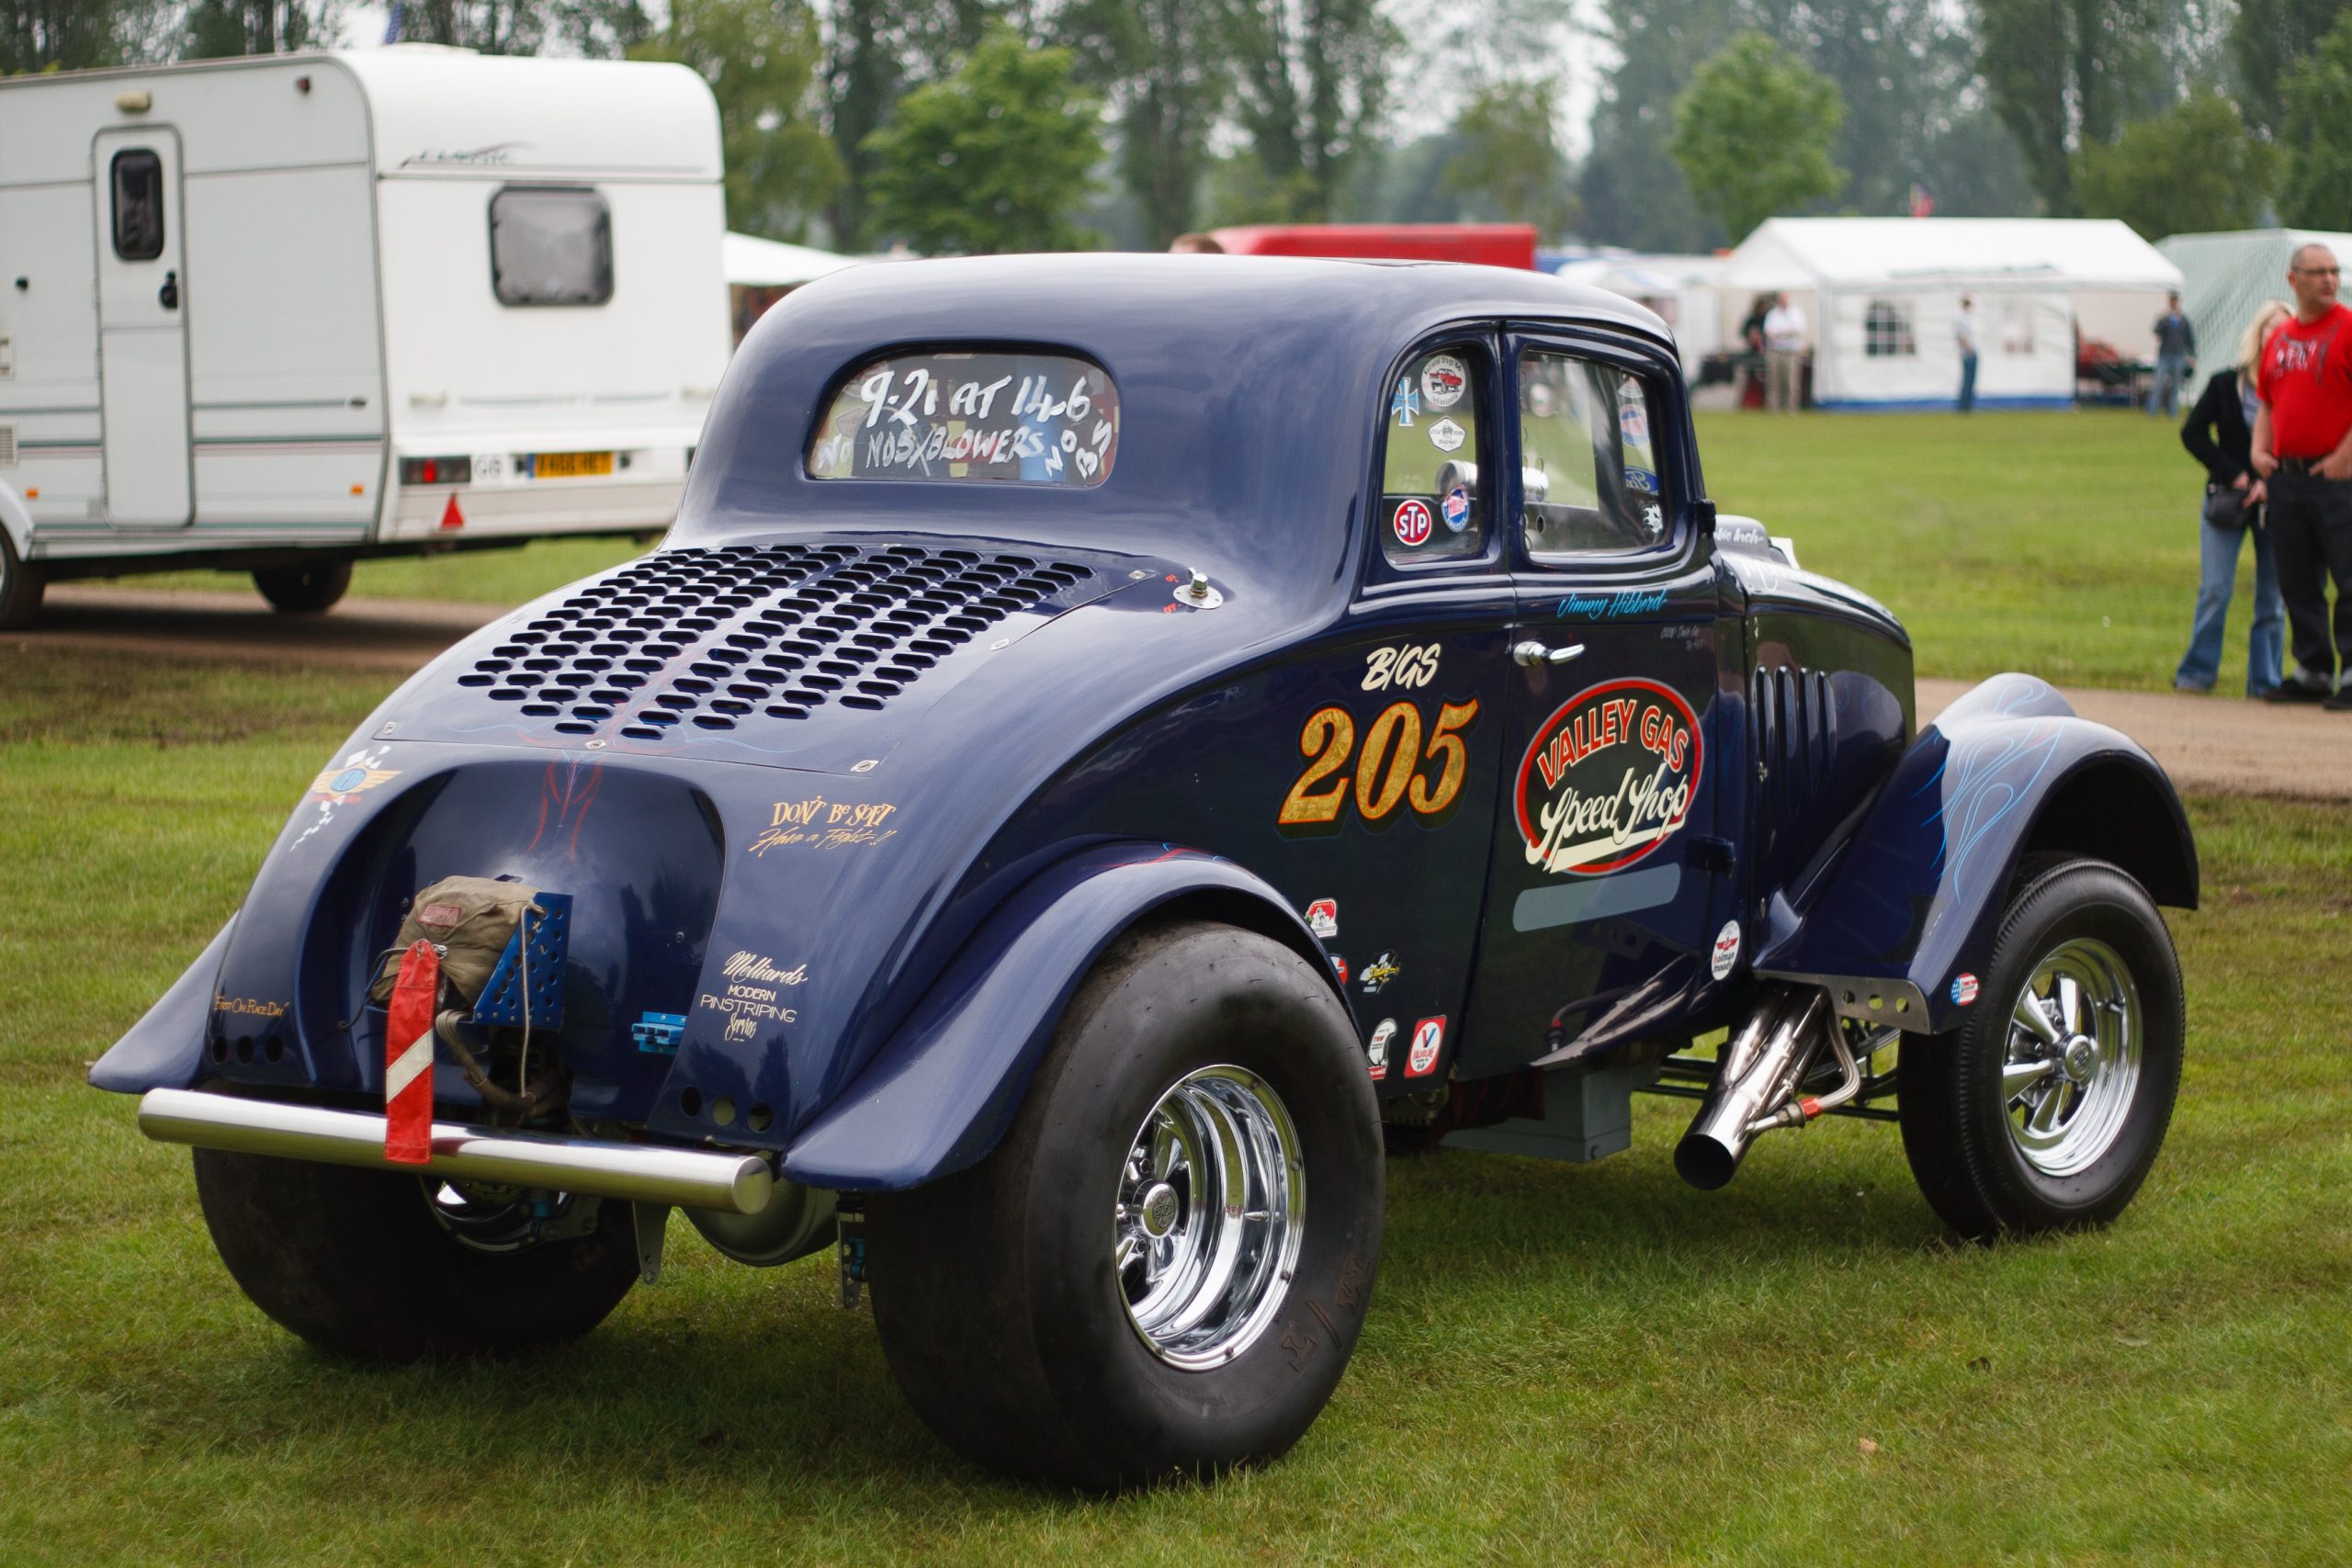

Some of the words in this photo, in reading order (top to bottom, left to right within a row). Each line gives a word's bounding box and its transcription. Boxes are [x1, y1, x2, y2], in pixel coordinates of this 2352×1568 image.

[950, 375, 1012, 419] AT
[474, 453, 502, 479] GB
[1398, 505, 1428, 540] STP
[1557, 591, 1608, 620] Jimmy
[1537, 699, 1637, 790] VALLEY
[1640, 705, 1689, 773] GAS
[1278, 698, 1478, 825] 205
[845, 803, 897, 827] SOFT
[1525, 767, 1634, 873] Speed
[1614, 762, 1689, 845] Shop
[749, 826, 805, 857] Have
[806, 833, 820, 842] a
[727, 984, 777, 1002] MODERN
[699, 994, 797, 1023] PINSTRIPING
[724, 1012, 757, 1042] Service
